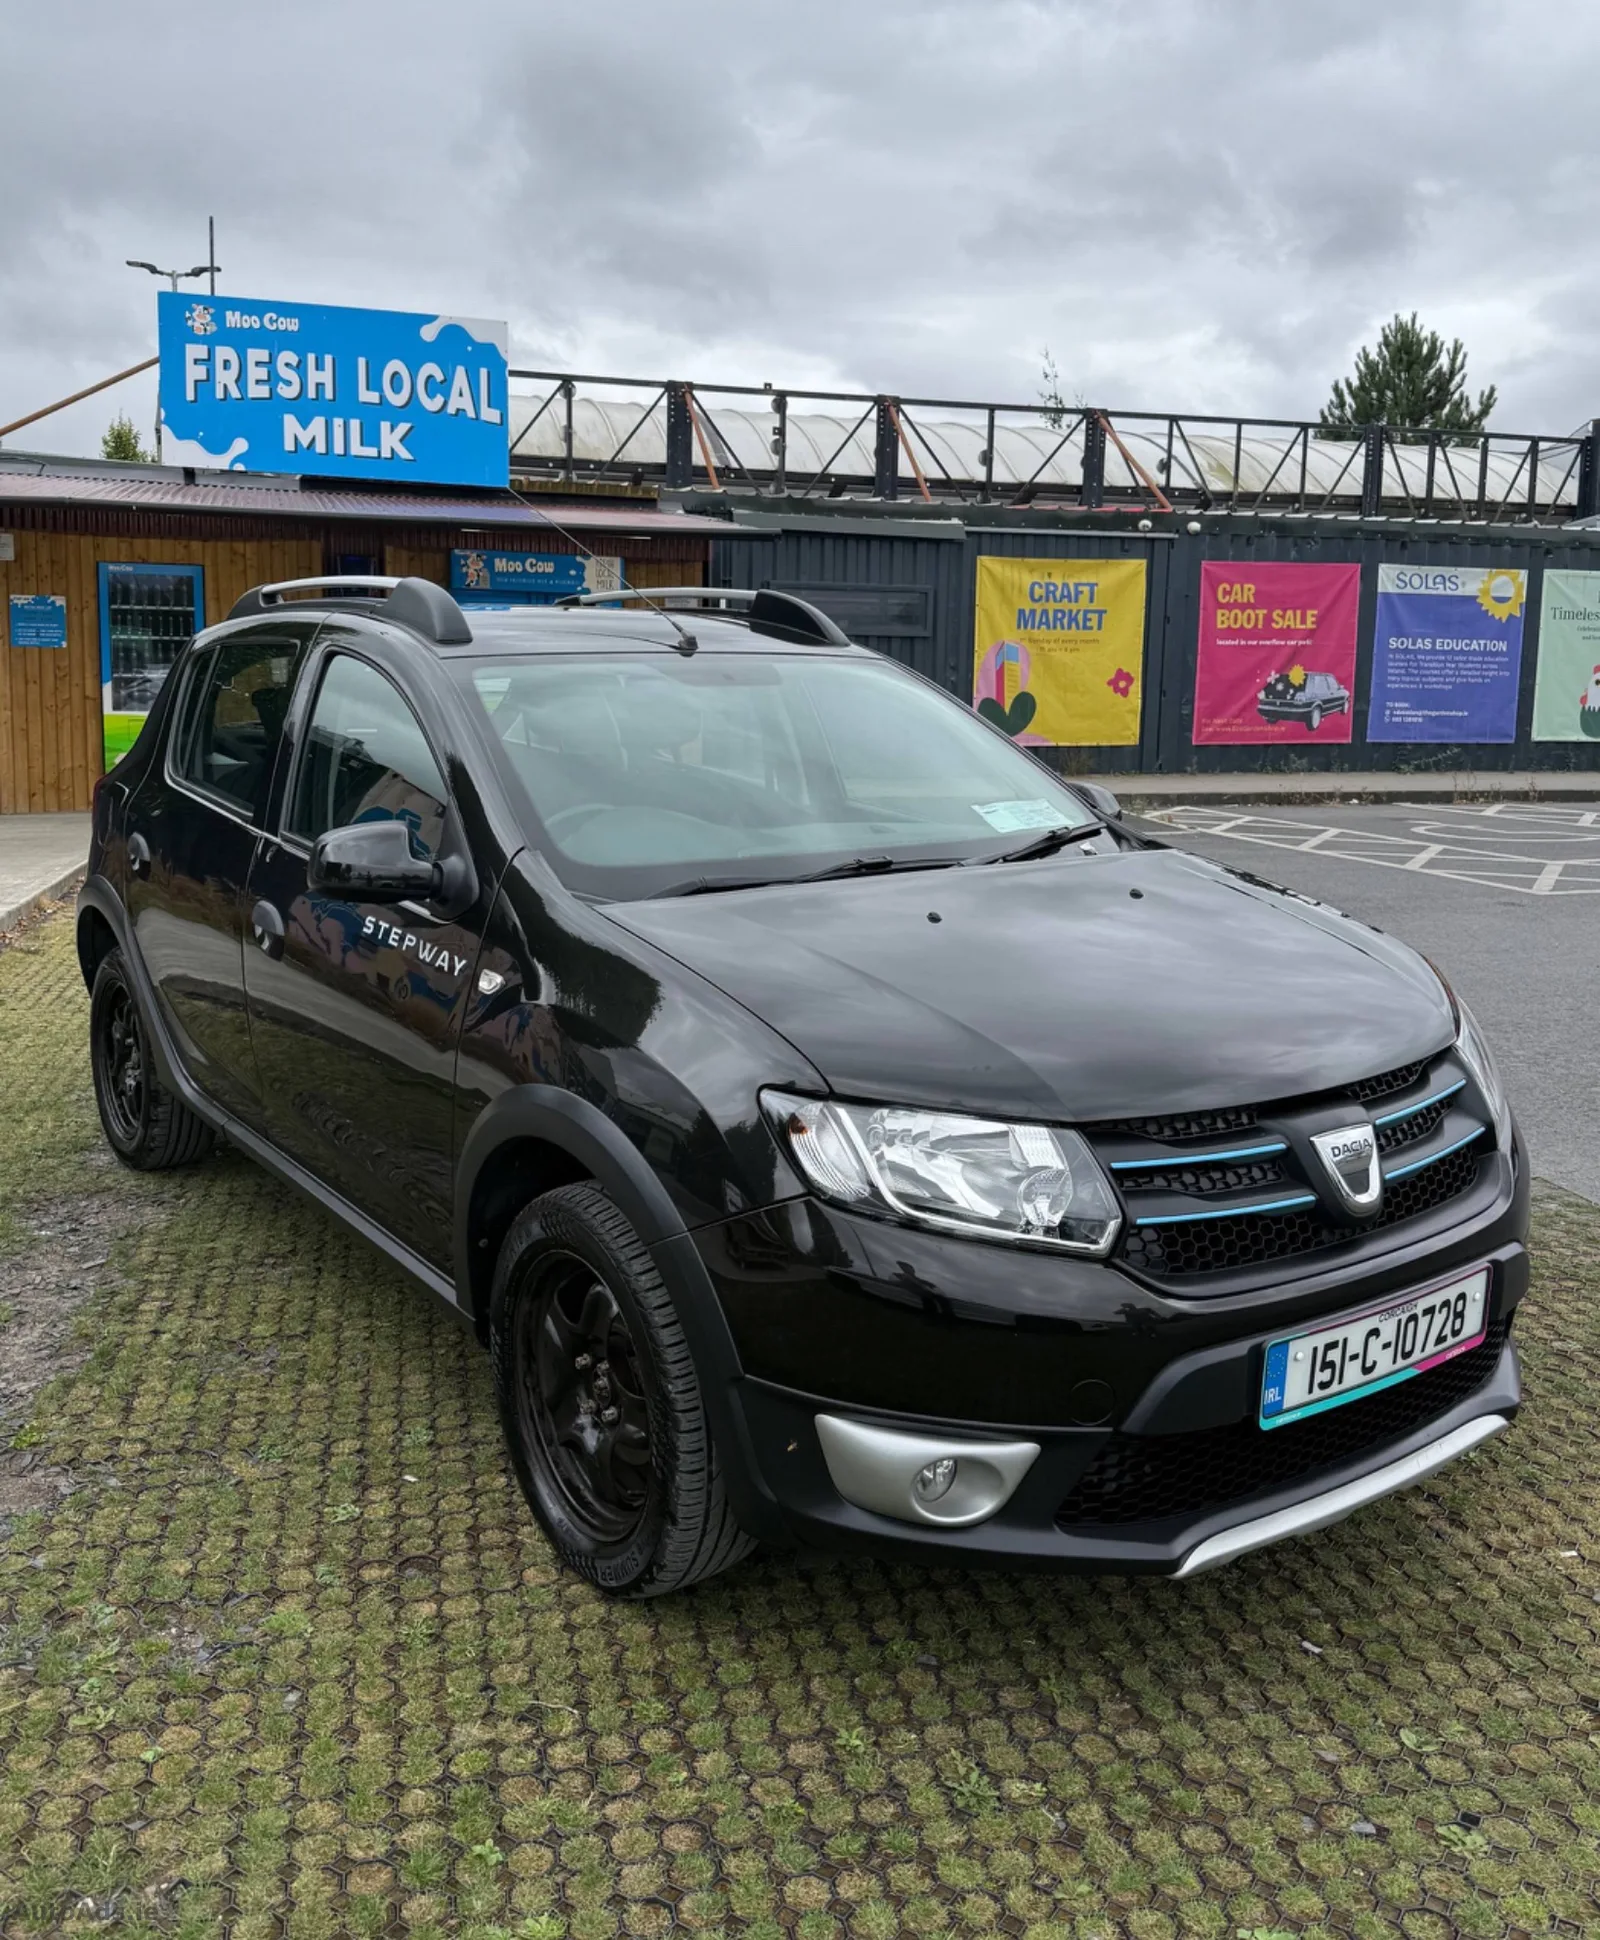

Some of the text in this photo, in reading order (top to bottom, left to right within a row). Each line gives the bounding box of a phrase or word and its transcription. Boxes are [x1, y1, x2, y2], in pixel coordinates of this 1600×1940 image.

[225, 310, 299, 332] Moo Cow
[184, 343, 504, 425] FRESH LOCAL
[283, 413, 416, 461] MILK
[494, 558, 554, 573] Moo Cow
[1395, 571, 1459, 591] SOLAS
[1029, 581, 1098, 603] CRAFT
[1217, 583, 1256, 604] CAR
[1016, 608, 1107, 631] MARKET
[1216, 609, 1318, 629] BOOT SALE
[1216, 638, 1239, 646] located
[1240, 638, 1246, 646] in
[1259, 638, 1285, 646] overflow
[1388, 637, 1507, 652] SOLAS EDUCATION
[362, 915, 467, 977] STEPWAY
[1330, 1138, 1373, 1158] DACIA
[1378, 1301, 1418, 1323] CORCAIGH
[1308, 1291, 1467, 1395] 151-C-10728
[1263, 1386, 1282, 1405] IRL
